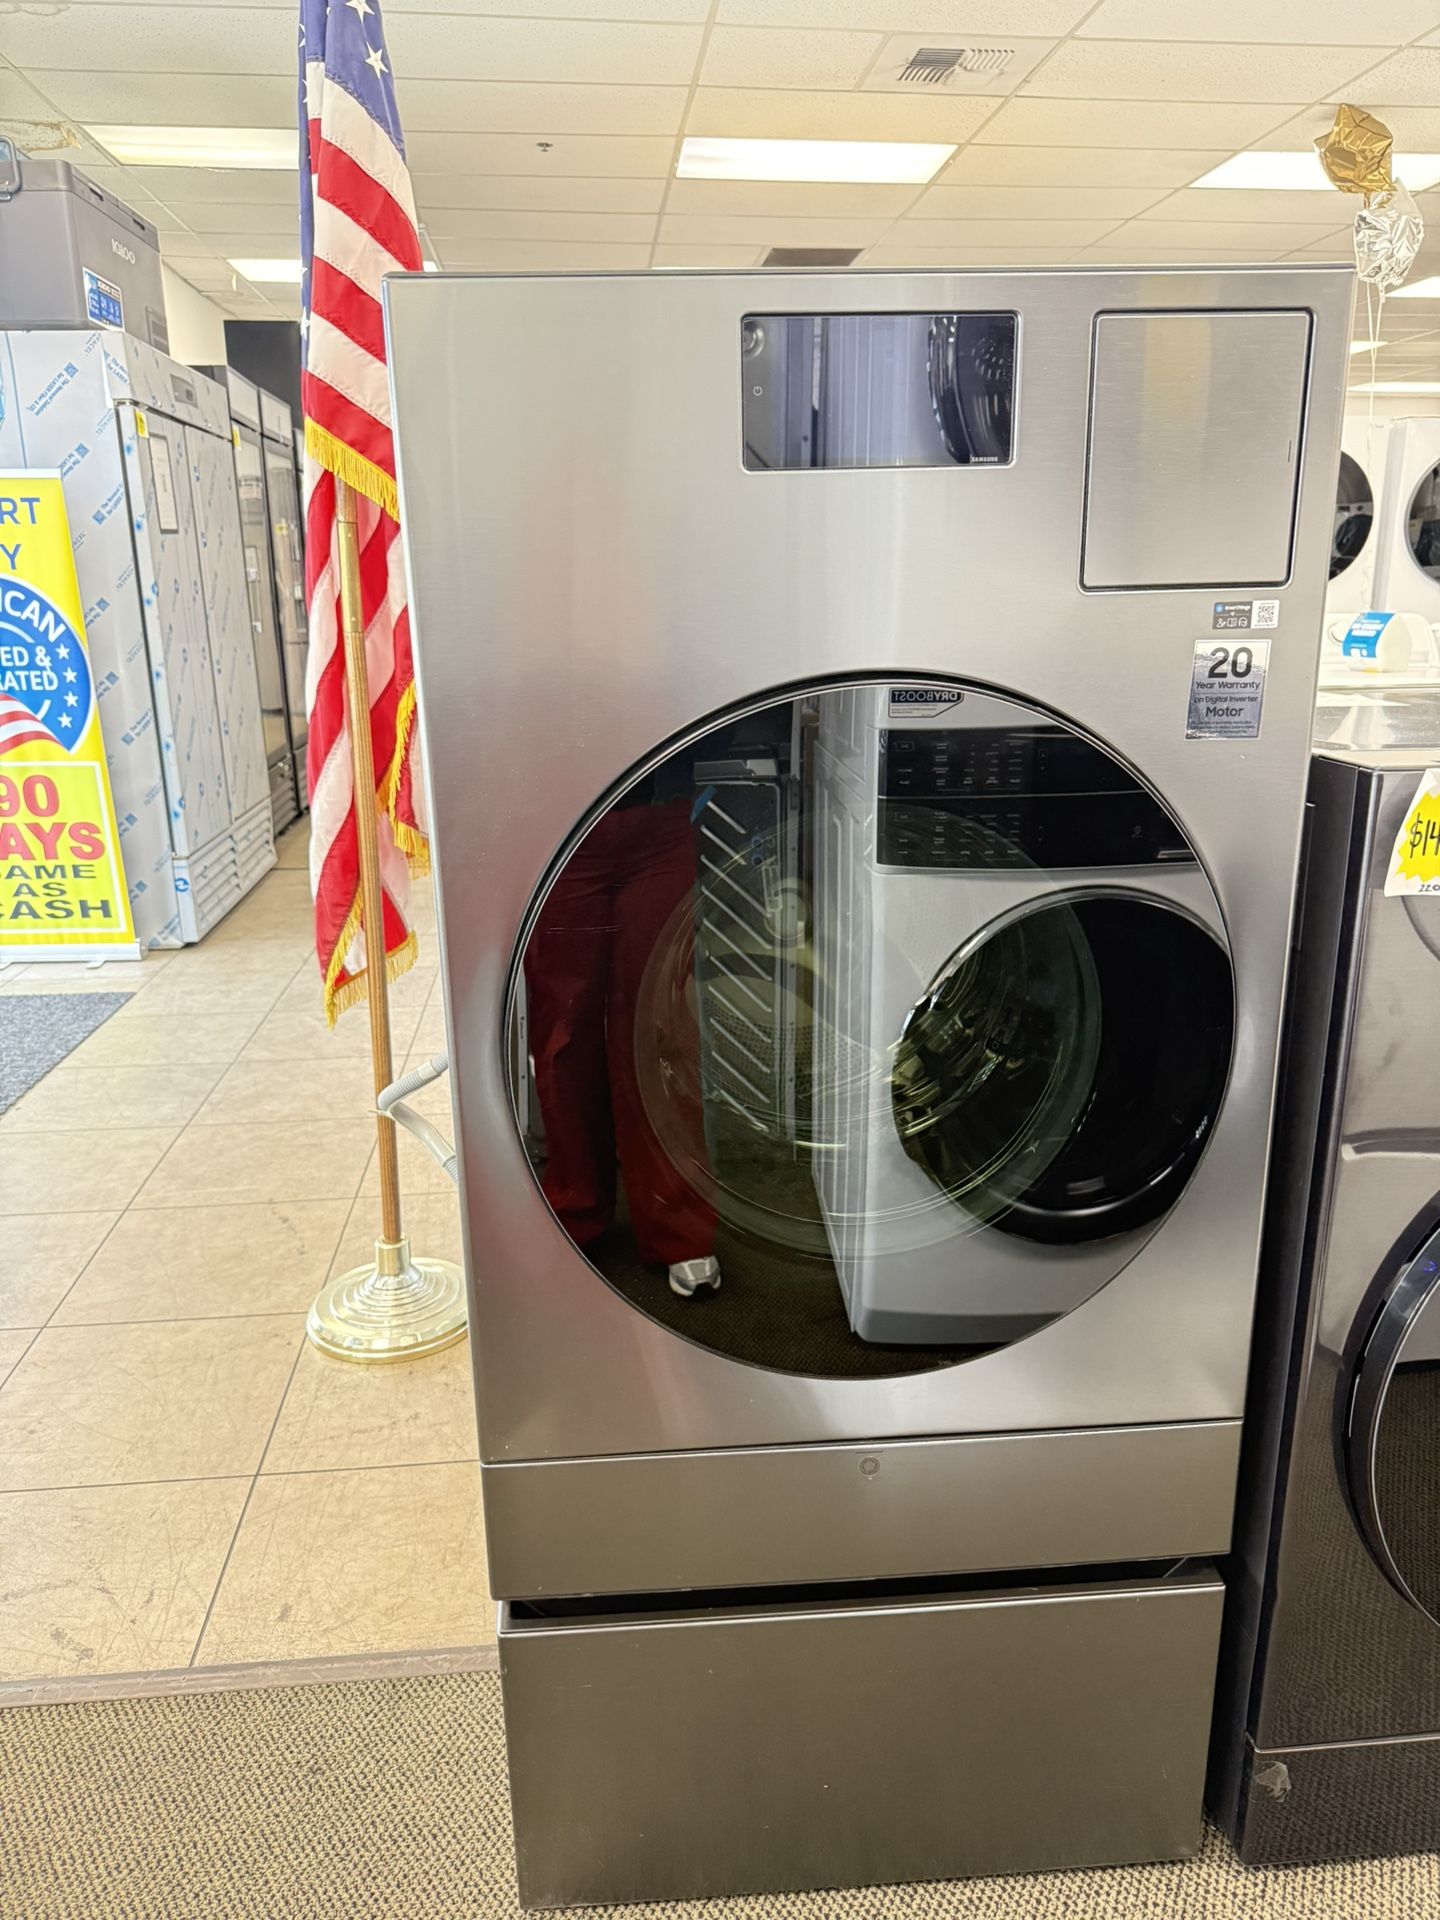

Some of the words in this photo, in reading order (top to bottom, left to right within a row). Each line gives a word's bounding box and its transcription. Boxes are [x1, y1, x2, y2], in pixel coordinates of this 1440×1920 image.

[112, 238, 136, 264] IGLOO
[35, 645, 52, 668] &
[1207, 647, 1253, 679] 20
[1195, 681, 1215, 689] Year
[1218, 681, 1261, 691] Warranty
[1205, 695, 1228, 704] Digital
[1228, 695, 1259, 703] Inverter
[1205, 706, 1244, 717] Motor
[0, 775, 60, 817] 90
[0, 864, 97, 880] AME
[13, 882, 67, 897] AS
[0, 899, 113, 919] ASH
